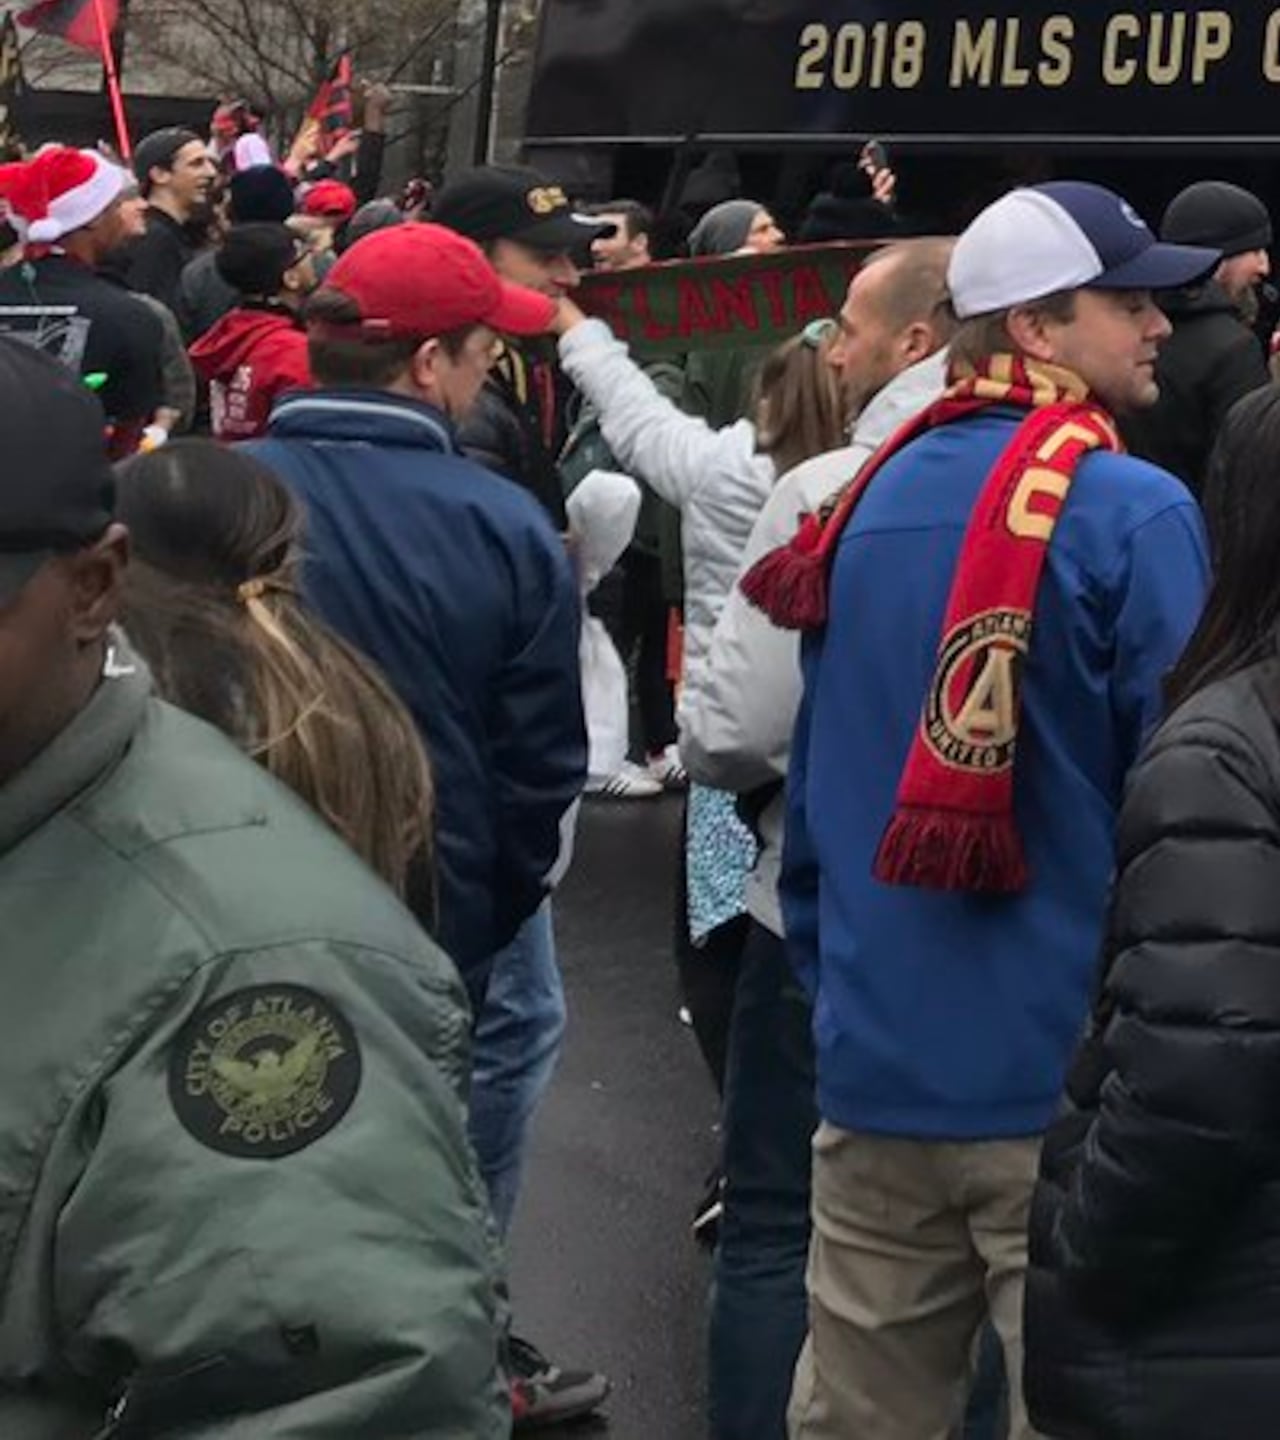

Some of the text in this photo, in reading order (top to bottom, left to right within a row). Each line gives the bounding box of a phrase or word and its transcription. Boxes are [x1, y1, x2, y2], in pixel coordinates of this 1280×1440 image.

[795, 21, 926, 89] 2018
[948, 14, 1075, 87] MLS
[1101, 10, 1232, 86] CUP
[576, 263, 832, 341] TLANTA
[929, 720, 998, 766] UNITED
[206, 1005, 242, 1039] OF
[252, 996, 346, 1062] ATLANTA
[218, 1091, 334, 1144] POLICE
